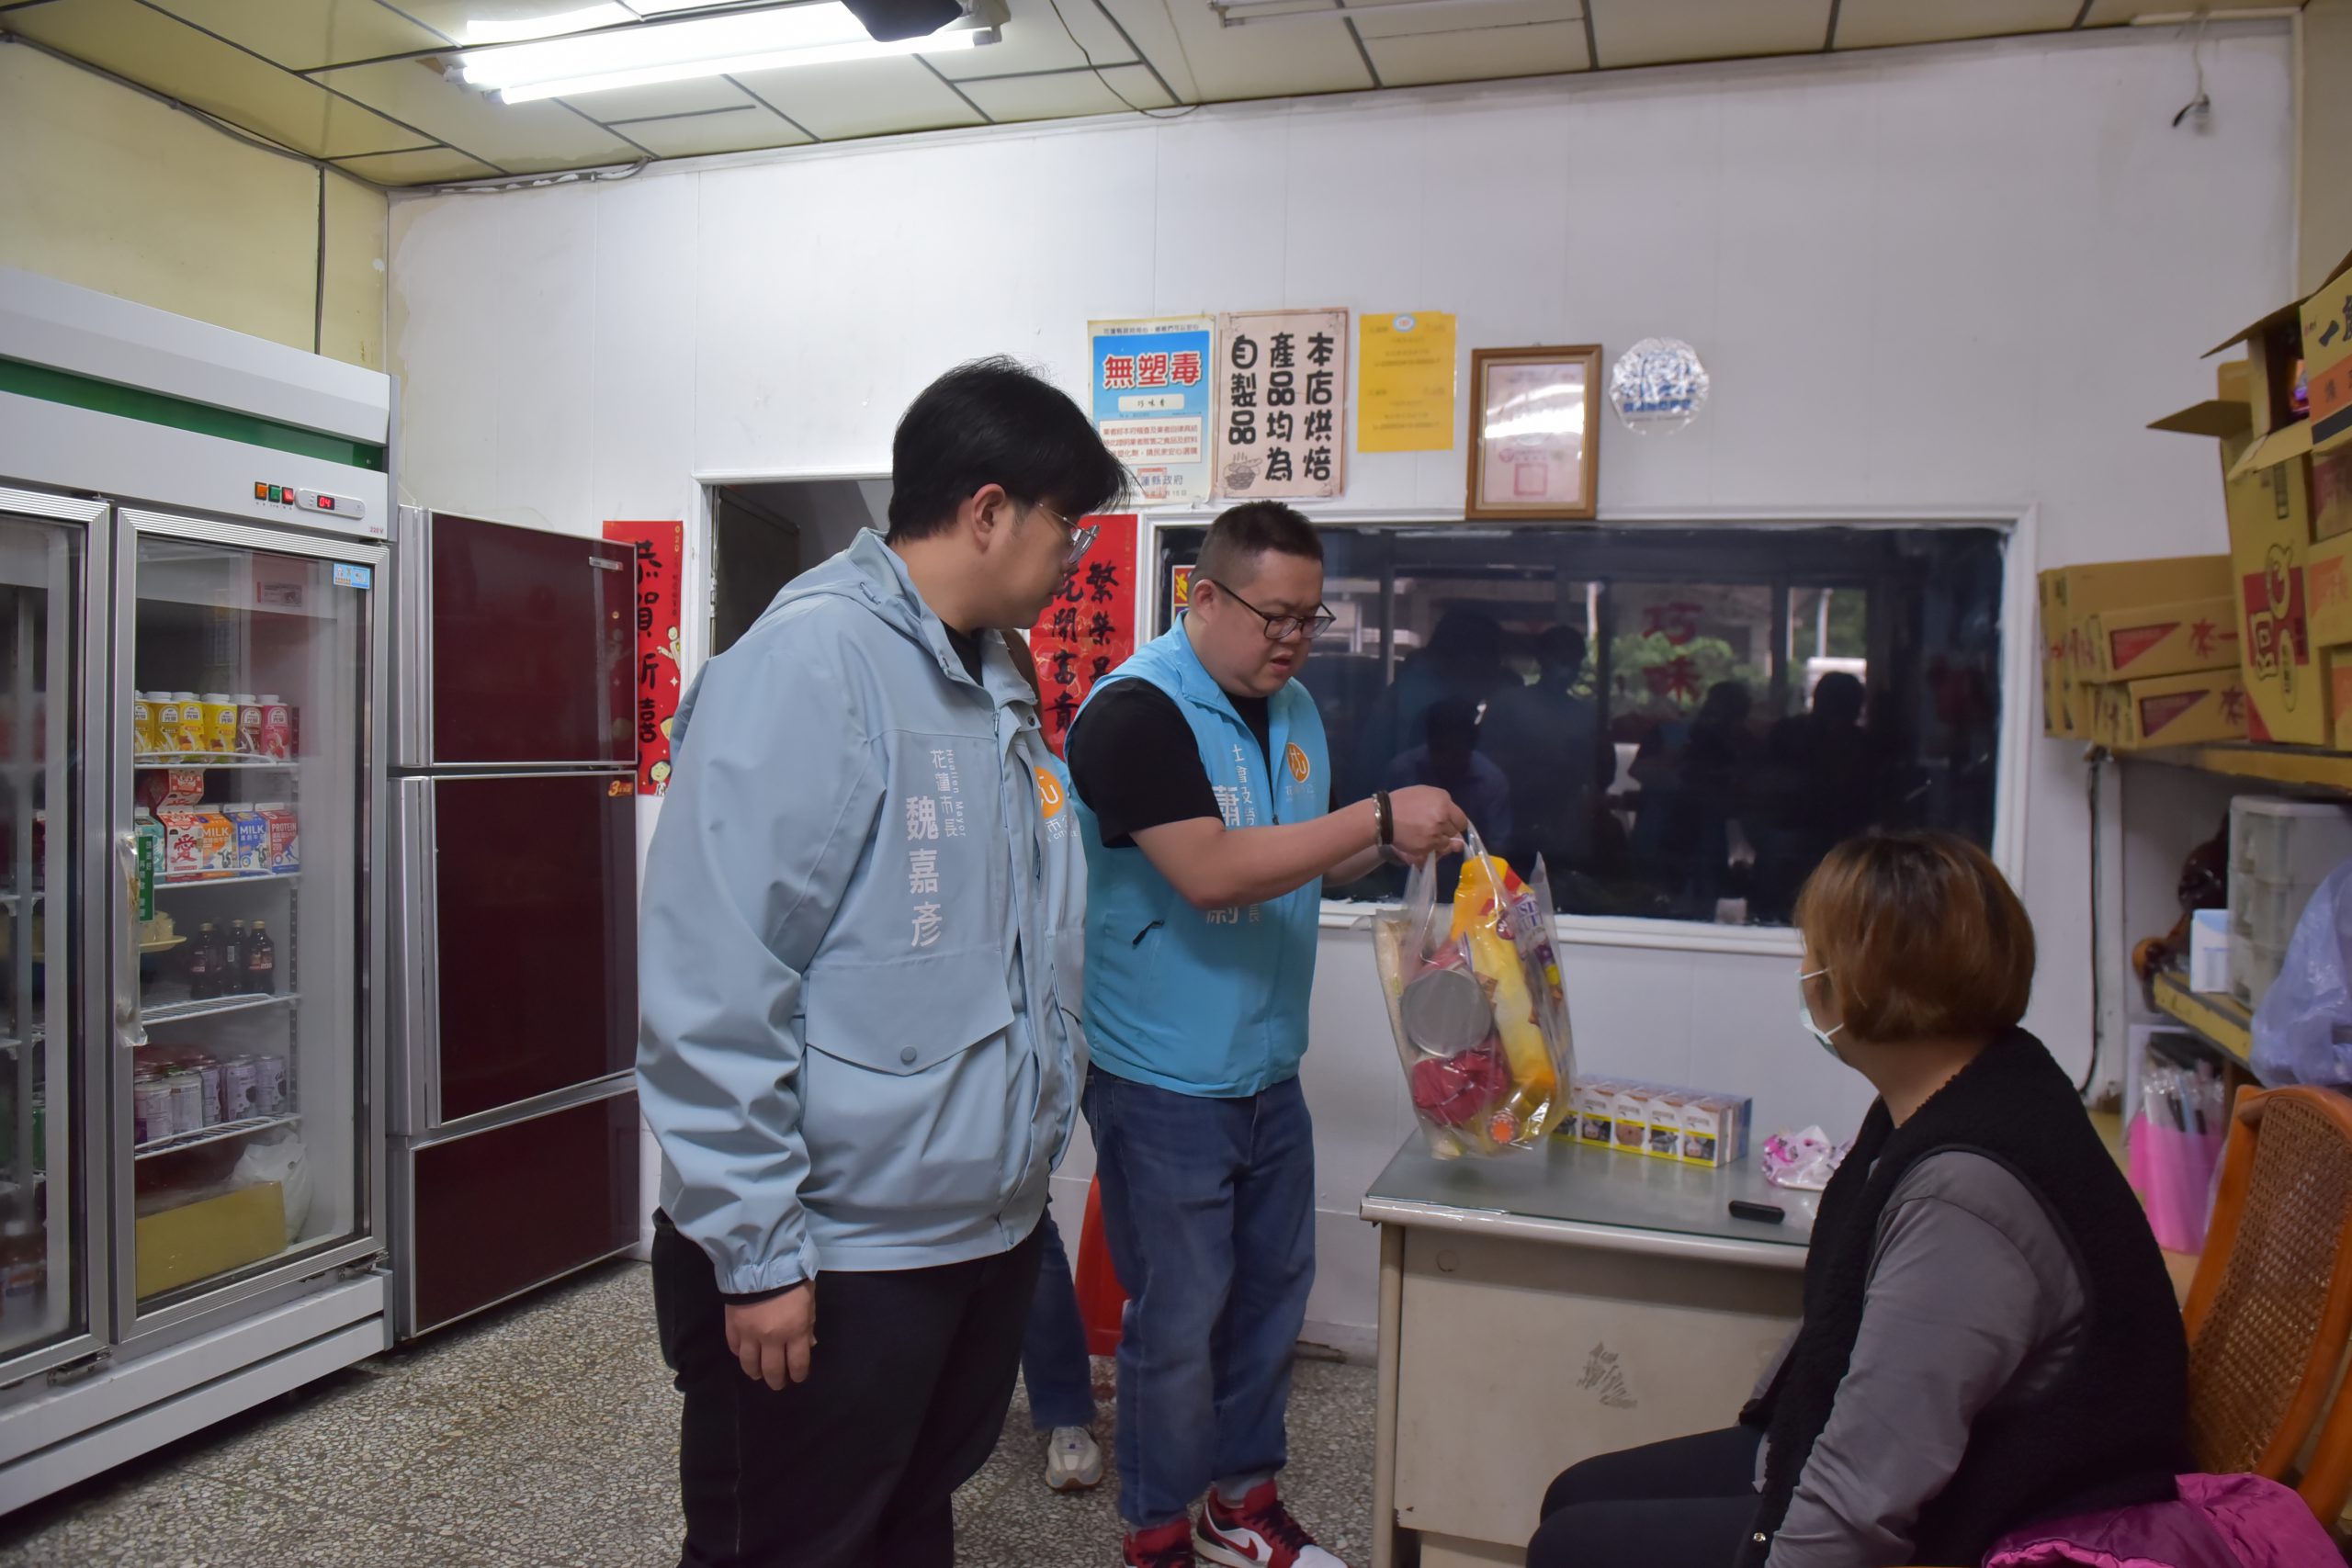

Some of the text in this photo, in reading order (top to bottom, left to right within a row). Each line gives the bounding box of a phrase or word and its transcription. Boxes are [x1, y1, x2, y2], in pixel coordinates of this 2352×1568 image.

[1103, 353, 1200, 388] 無塑毒
[1227, 334, 1258, 445] 自製品
[1265, 333, 1295, 482] 產品均為
[1304, 333, 1335, 481] 本店烘焙
[201, 827, 229, 837] MILK
[240, 824, 265, 835] MILK
[272, 823, 297, 831] PROTEIN
[930, 750, 958, 837] 花蓮市長
[946, 750, 966, 838] Hualien Mayor
[906, 795, 943, 948] 魏嘉彥
